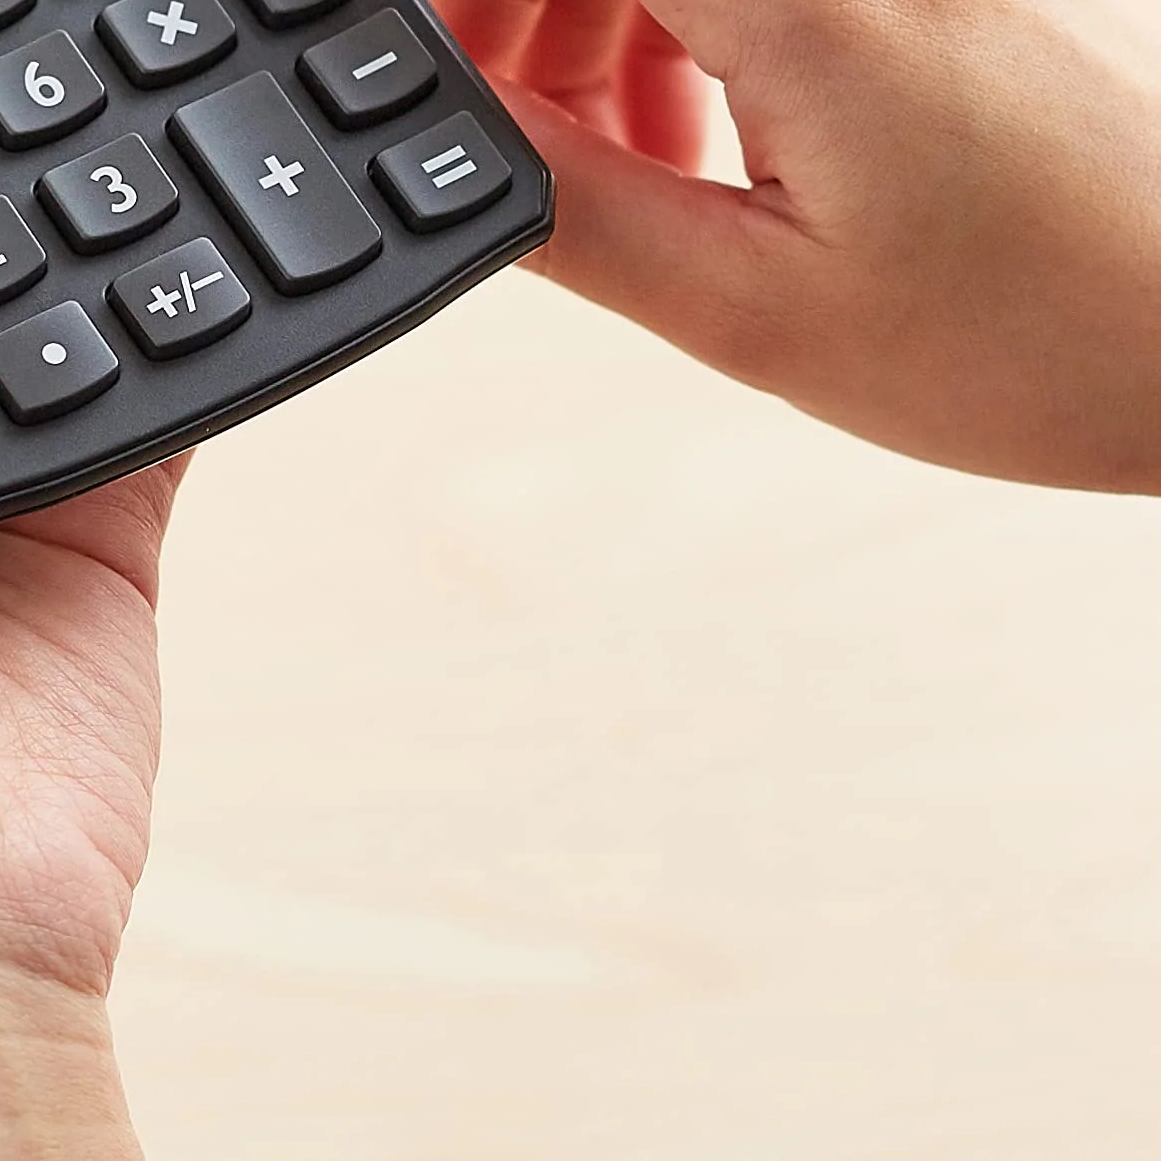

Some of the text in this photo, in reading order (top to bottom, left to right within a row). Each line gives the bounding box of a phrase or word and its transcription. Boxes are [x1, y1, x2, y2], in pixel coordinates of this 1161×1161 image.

[24, 61, 66, 107] 6
[89, 166, 138, 213] 3
[258, 155, 305, 197] +
[421, 145, 477, 189] =
